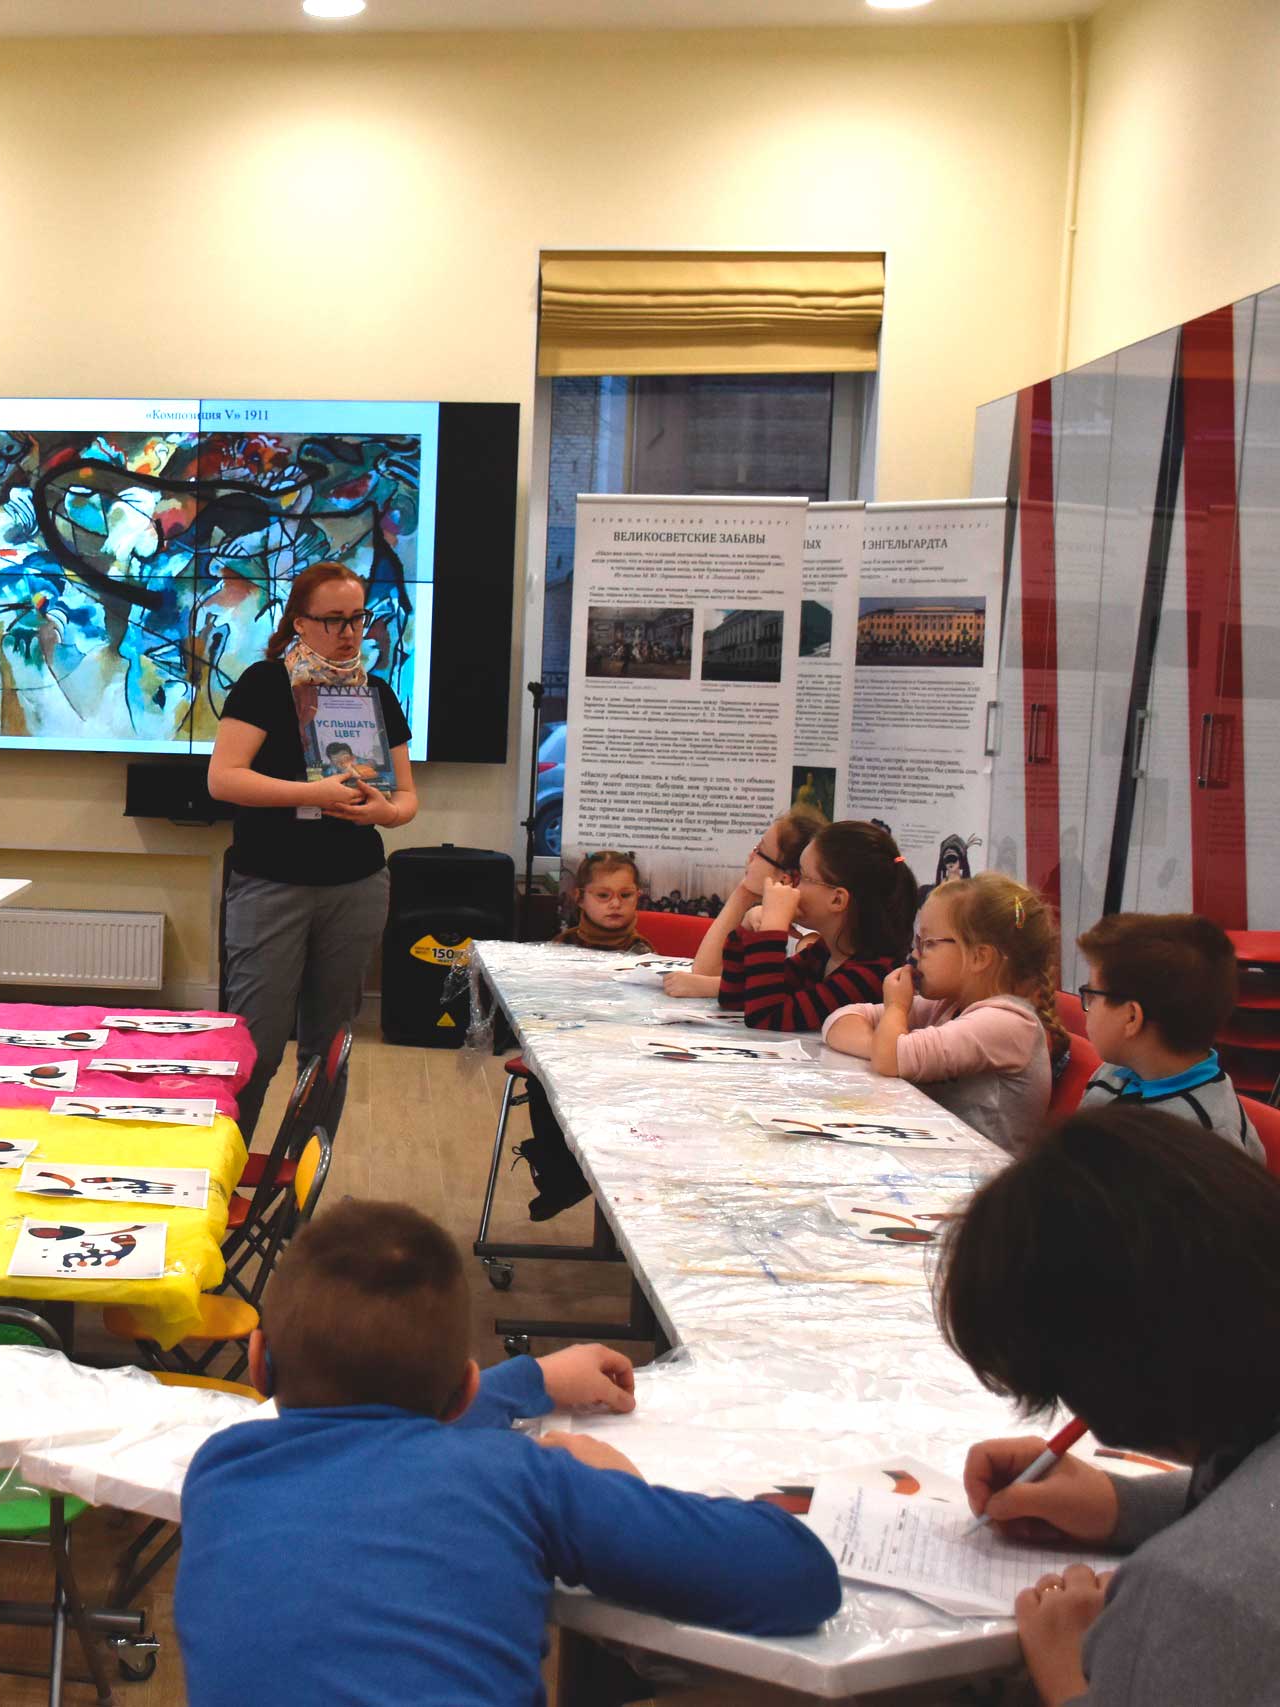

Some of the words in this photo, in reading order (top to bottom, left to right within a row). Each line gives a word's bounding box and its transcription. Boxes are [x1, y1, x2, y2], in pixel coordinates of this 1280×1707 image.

[225, 409, 241, 420] V»
[245, 410, 269, 420] 1911
[613, 531, 717, 544] ВЕЛИКОСВЕТСКИЕ
[719, 532, 766, 545] ЗАБАВЫ
[868, 538, 948, 550] ЭНГЕЛЬГАРДТА
[316, 719, 376, 729] УСЛЫШАТЬ
[334, 729, 361, 738] ЦВЕТ
